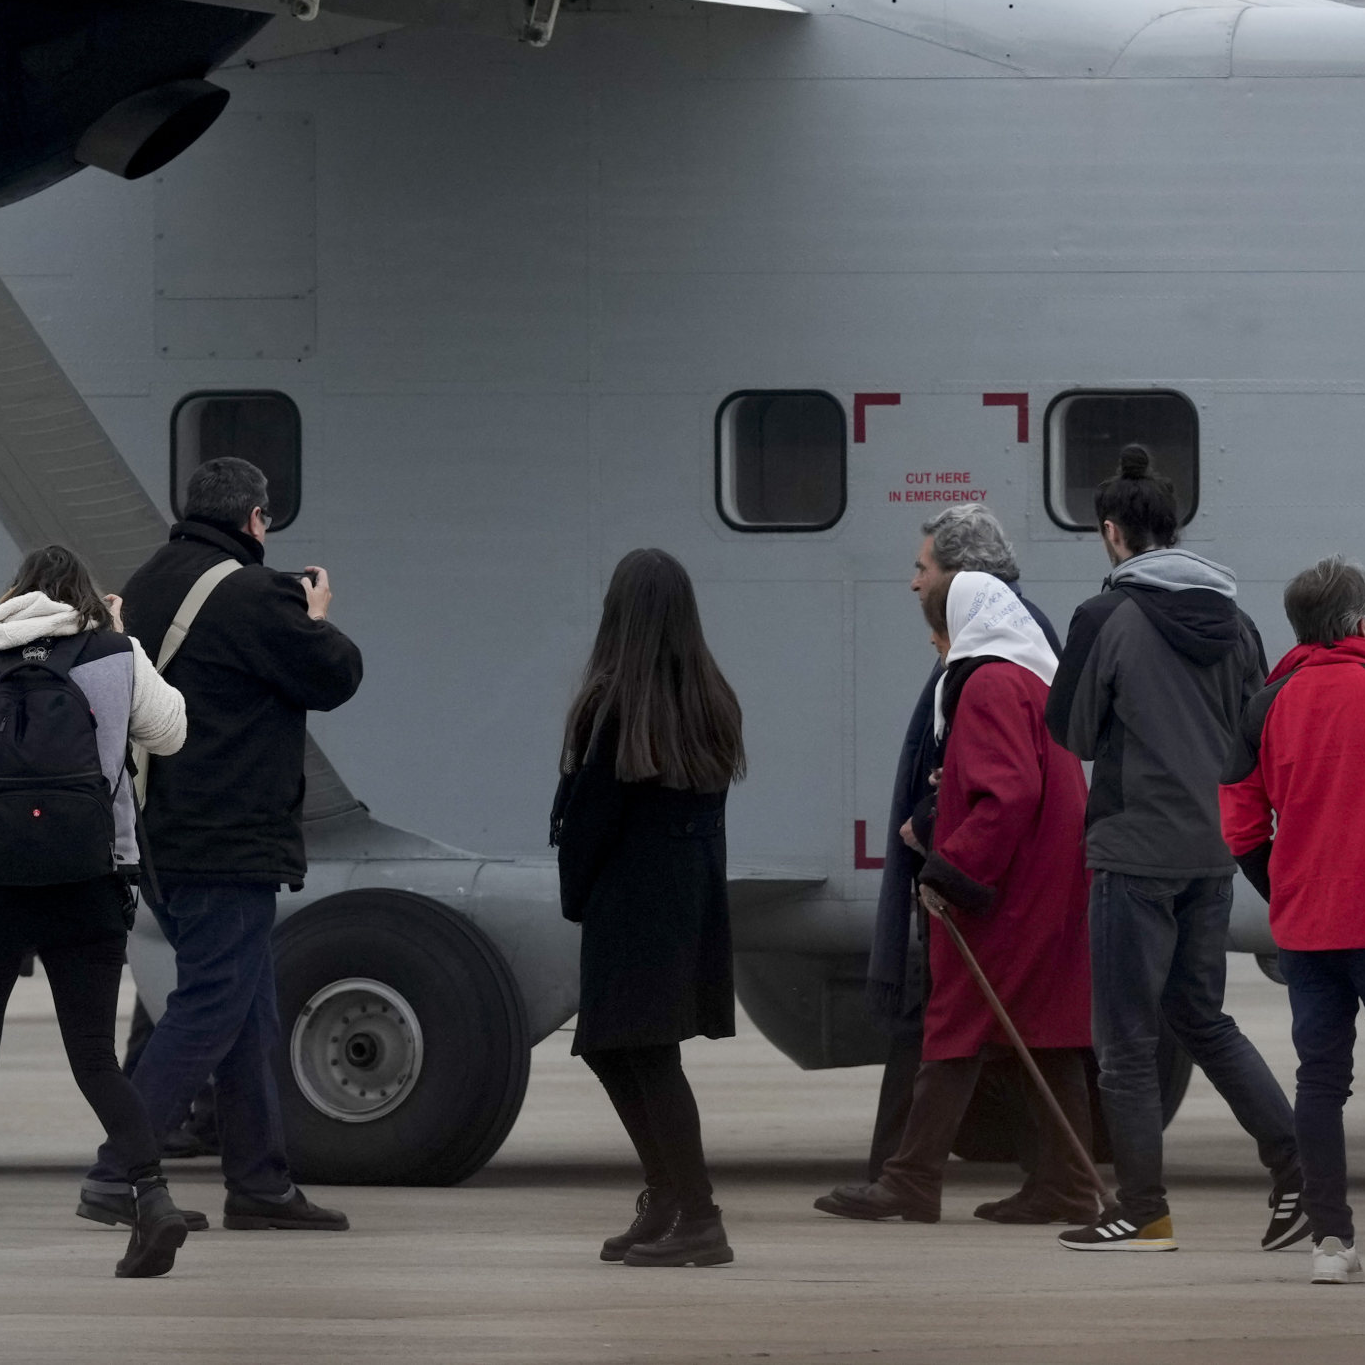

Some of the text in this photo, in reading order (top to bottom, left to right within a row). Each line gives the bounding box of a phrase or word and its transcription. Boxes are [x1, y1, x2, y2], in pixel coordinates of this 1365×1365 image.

[905, 472, 971, 484] CUT HERE
[888, 490, 988, 503] IN EMERGENCY
